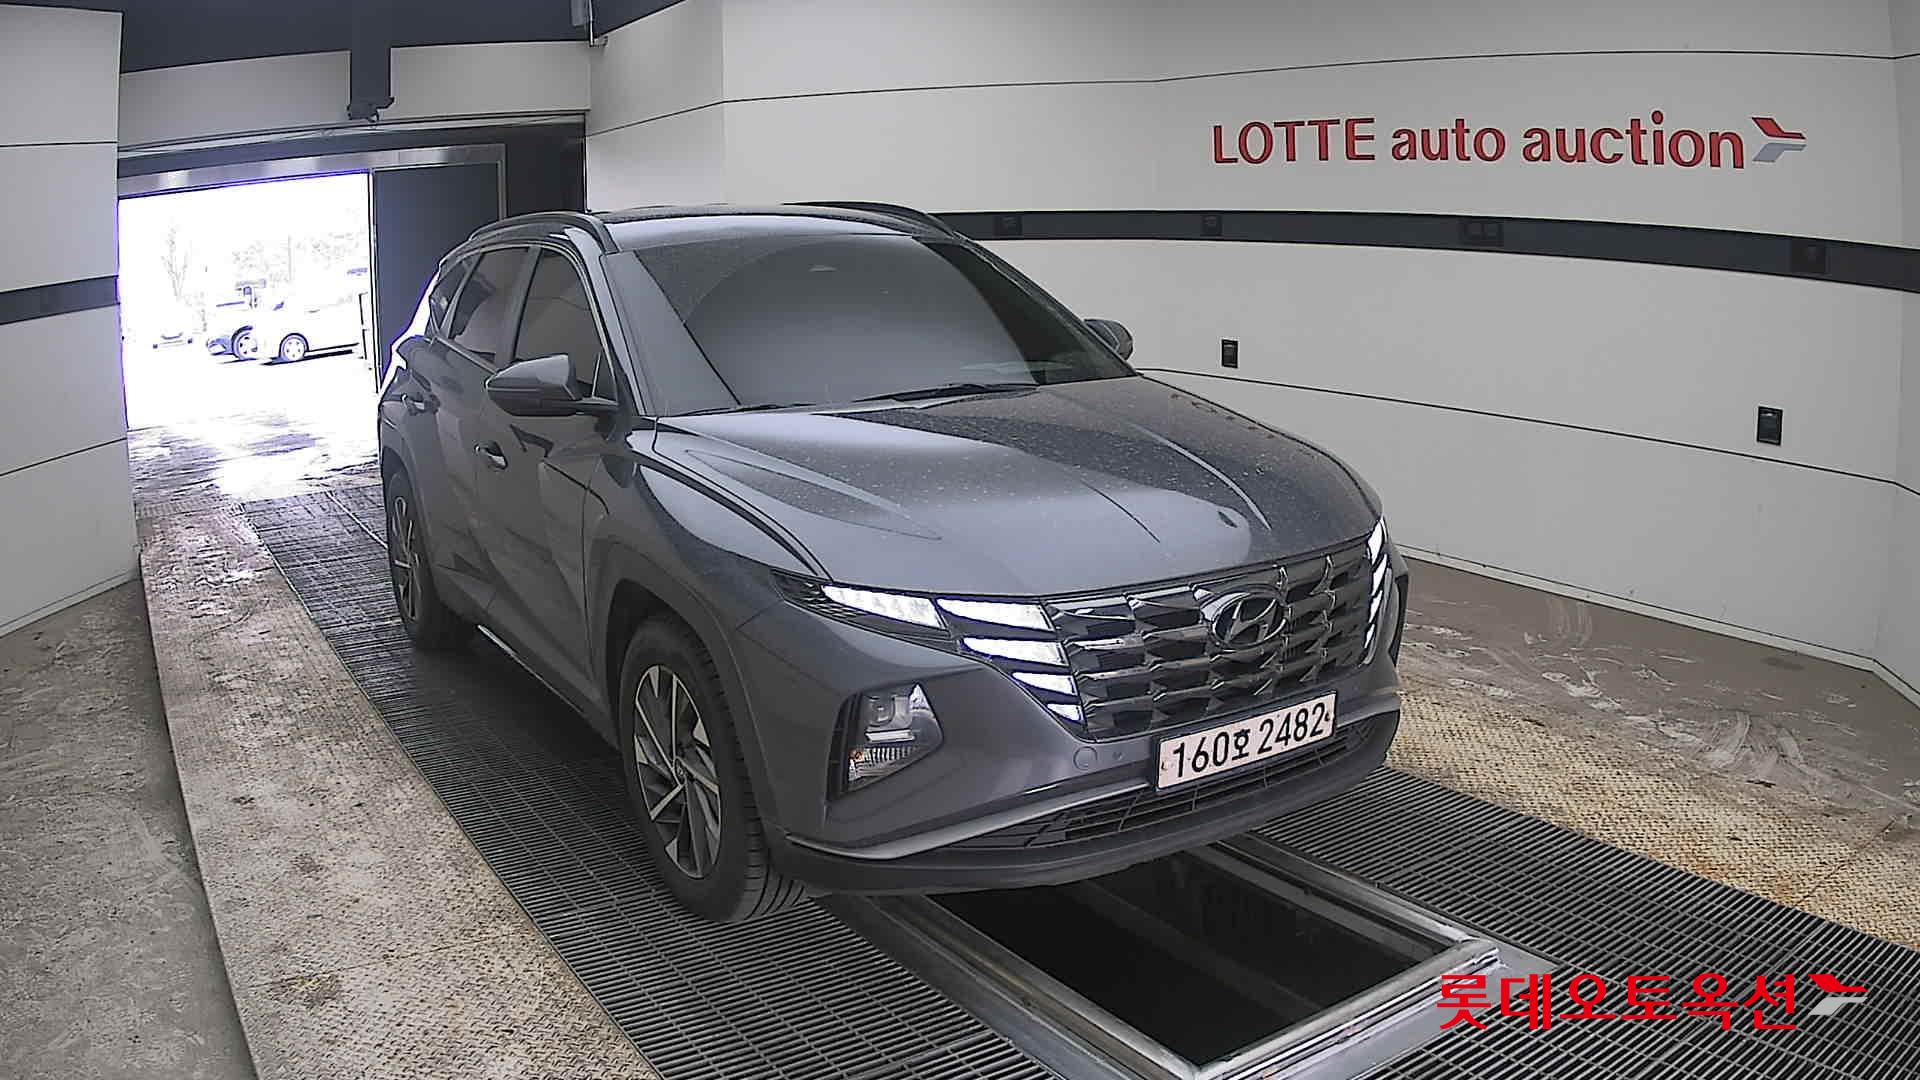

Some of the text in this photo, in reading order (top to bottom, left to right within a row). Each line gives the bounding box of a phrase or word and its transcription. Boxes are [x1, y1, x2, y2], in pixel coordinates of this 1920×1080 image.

[1212, 110, 1745, 169] LOTTE auto auction
[1173, 702, 1326, 778] 160호 2482
